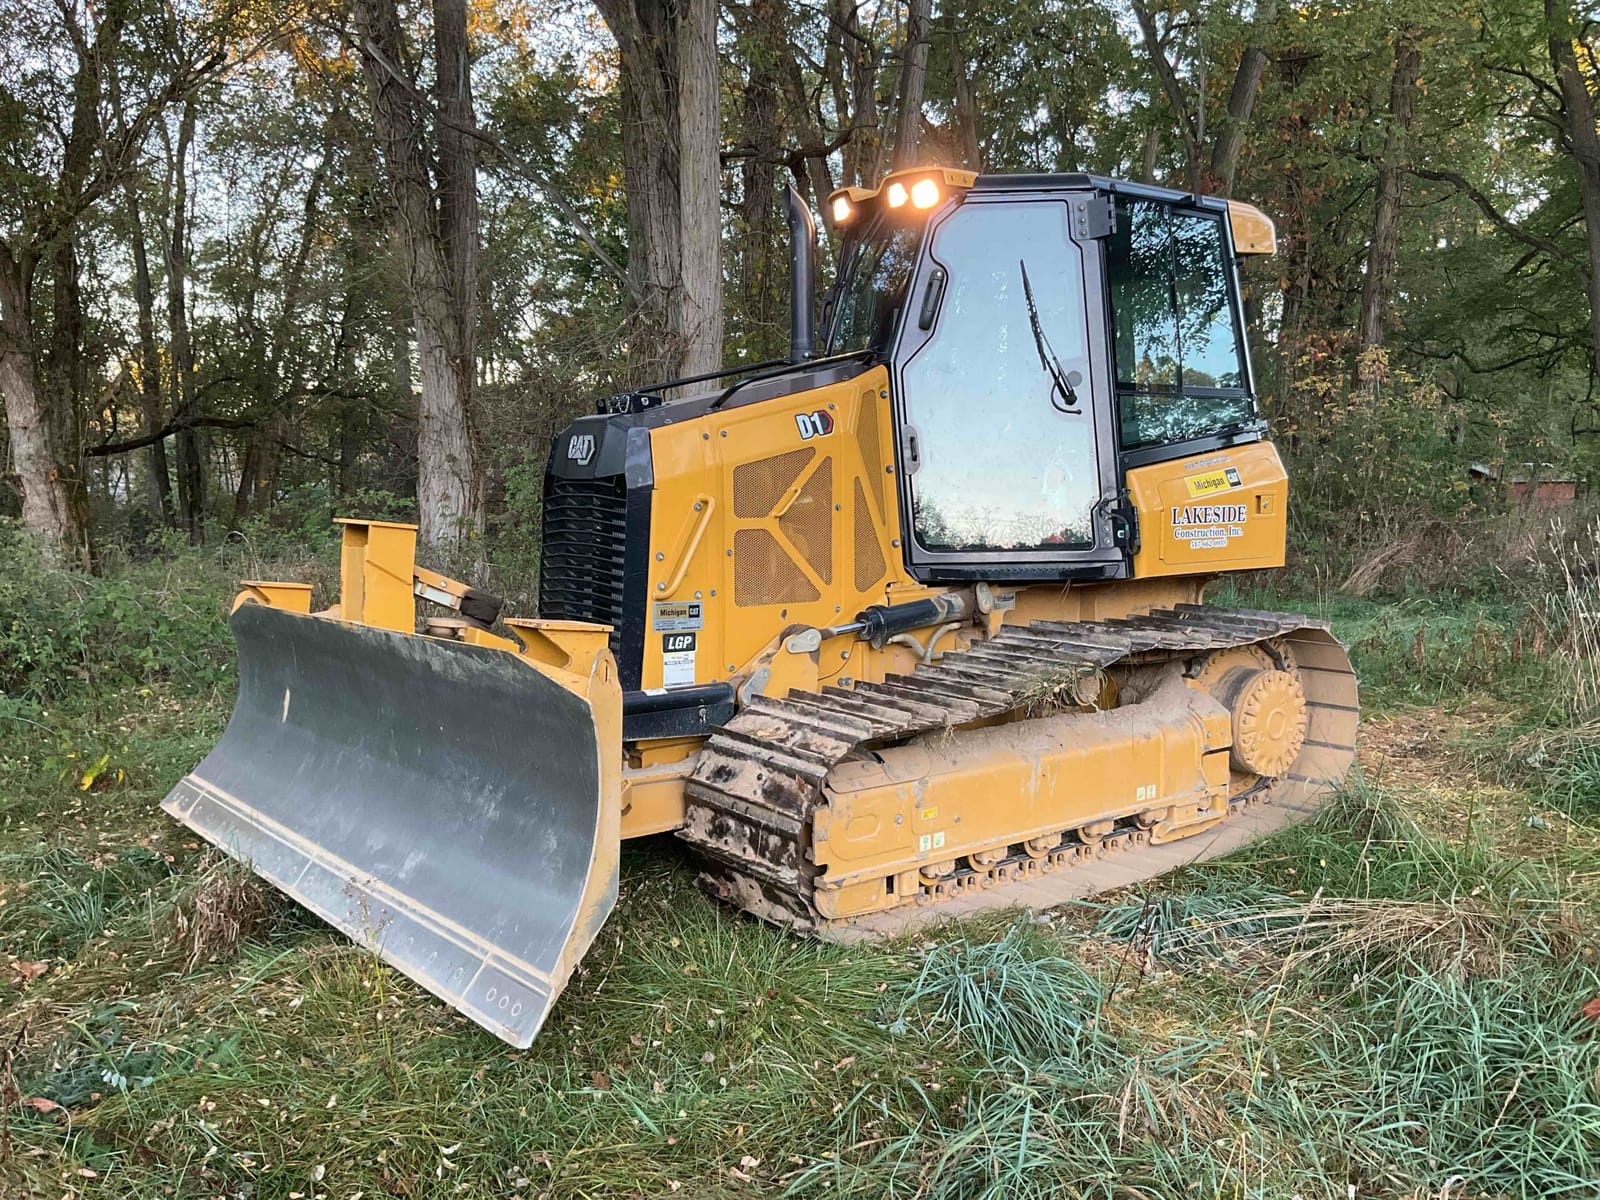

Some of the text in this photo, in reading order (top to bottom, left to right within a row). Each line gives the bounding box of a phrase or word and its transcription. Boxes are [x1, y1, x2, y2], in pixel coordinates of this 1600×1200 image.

[795, 412, 824, 439] D1
[568, 435, 594, 460] CAT
[1193, 477, 1225, 490] Michigan
[1172, 506, 1246, 525] LAKESIDE
[660, 608, 687, 617] Michigan
[668, 636, 692, 650] LGP
